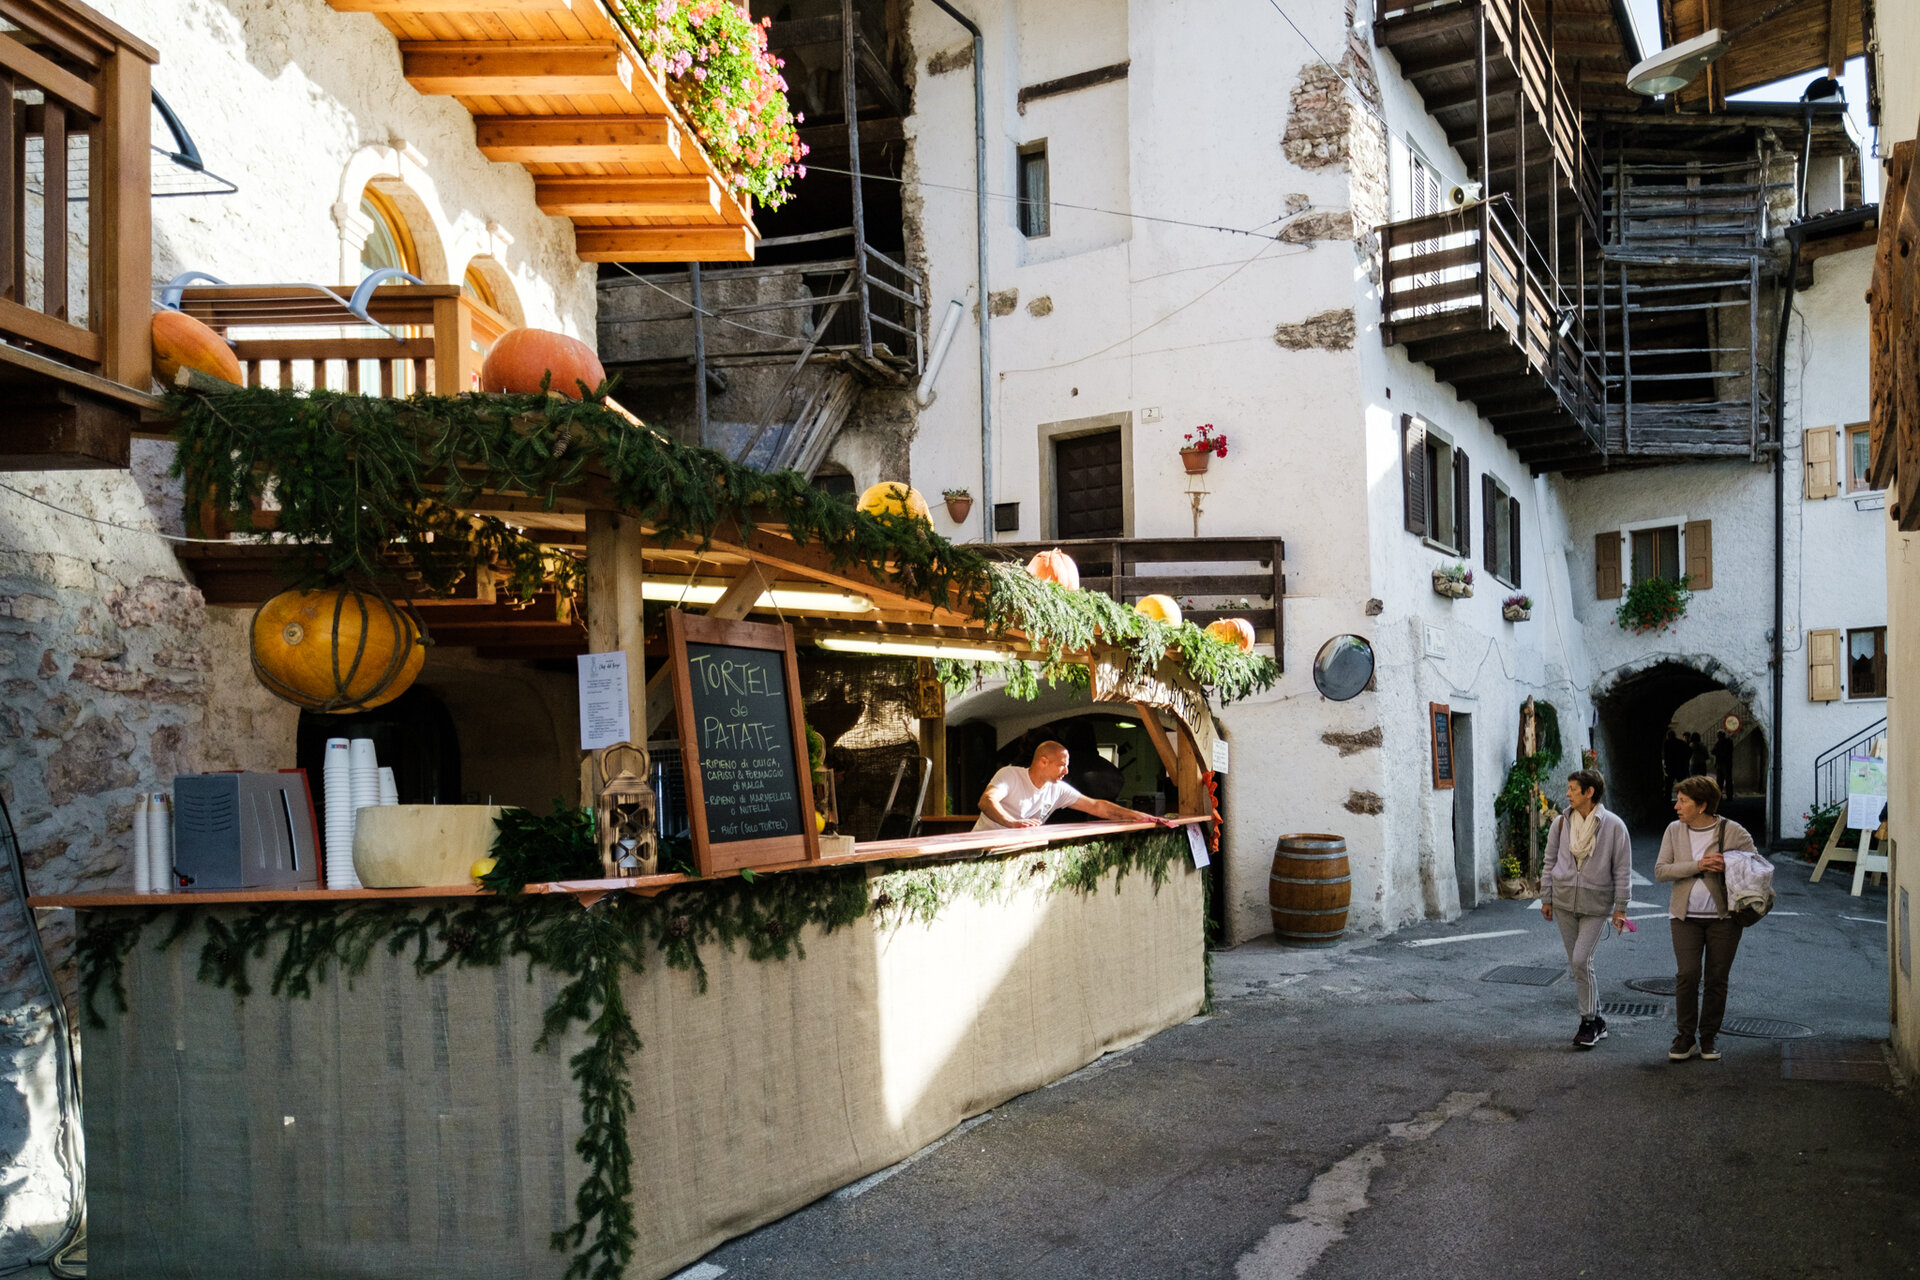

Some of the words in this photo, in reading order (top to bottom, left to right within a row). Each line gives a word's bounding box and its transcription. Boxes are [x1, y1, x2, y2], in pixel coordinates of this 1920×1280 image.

[1147, 409, 1152, 417] 2
[690, 654, 781, 696] TORTEL
[730, 699, 748, 717] de
[1169, 677, 1201, 734] BORGO
[704, 716, 781, 752] PATATE
[741, 759, 749, 769] di
[737, 769, 745, 780] &
[745, 769, 784, 780] FORMAGGIO
[741, 780, 765, 791] MALGA
[749, 791, 792, 804] MARMELLATA
[739, 803, 771, 815] NUTELLA
